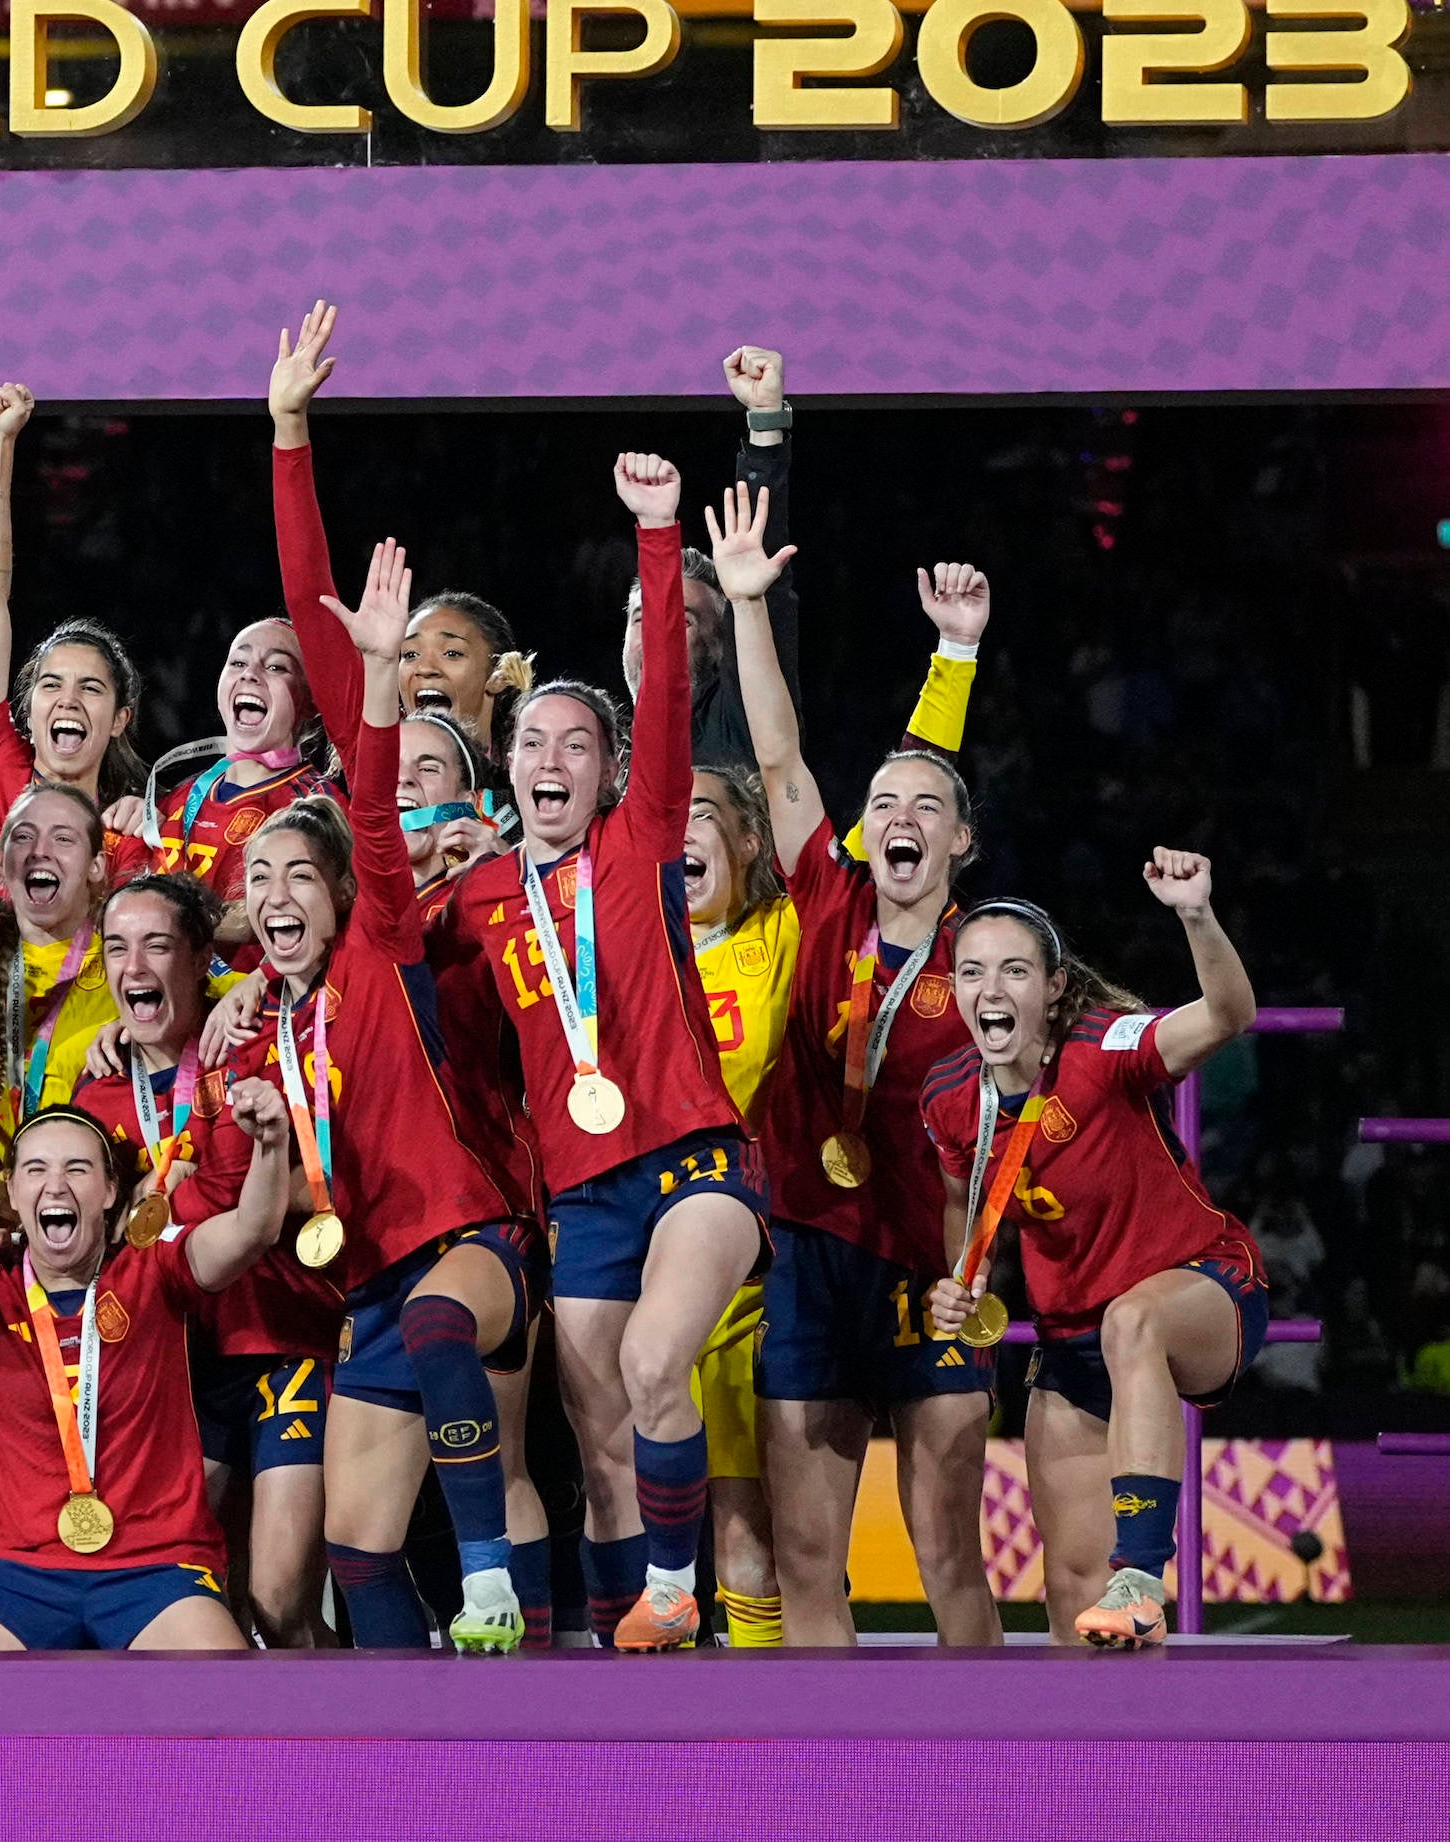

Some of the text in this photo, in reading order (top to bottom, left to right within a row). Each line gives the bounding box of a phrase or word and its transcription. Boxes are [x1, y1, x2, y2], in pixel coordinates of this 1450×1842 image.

[235, 0, 682, 133] CUP
[753, 0, 1414, 130] 2023
[980, 1122, 991, 1156] WORLD
[1013, 1166, 1065, 1220] 6
[85, 1332, 94, 1363] WORLD
[84, 1364, 92, 1381] CUP
[256, 1358, 318, 1422] 12
